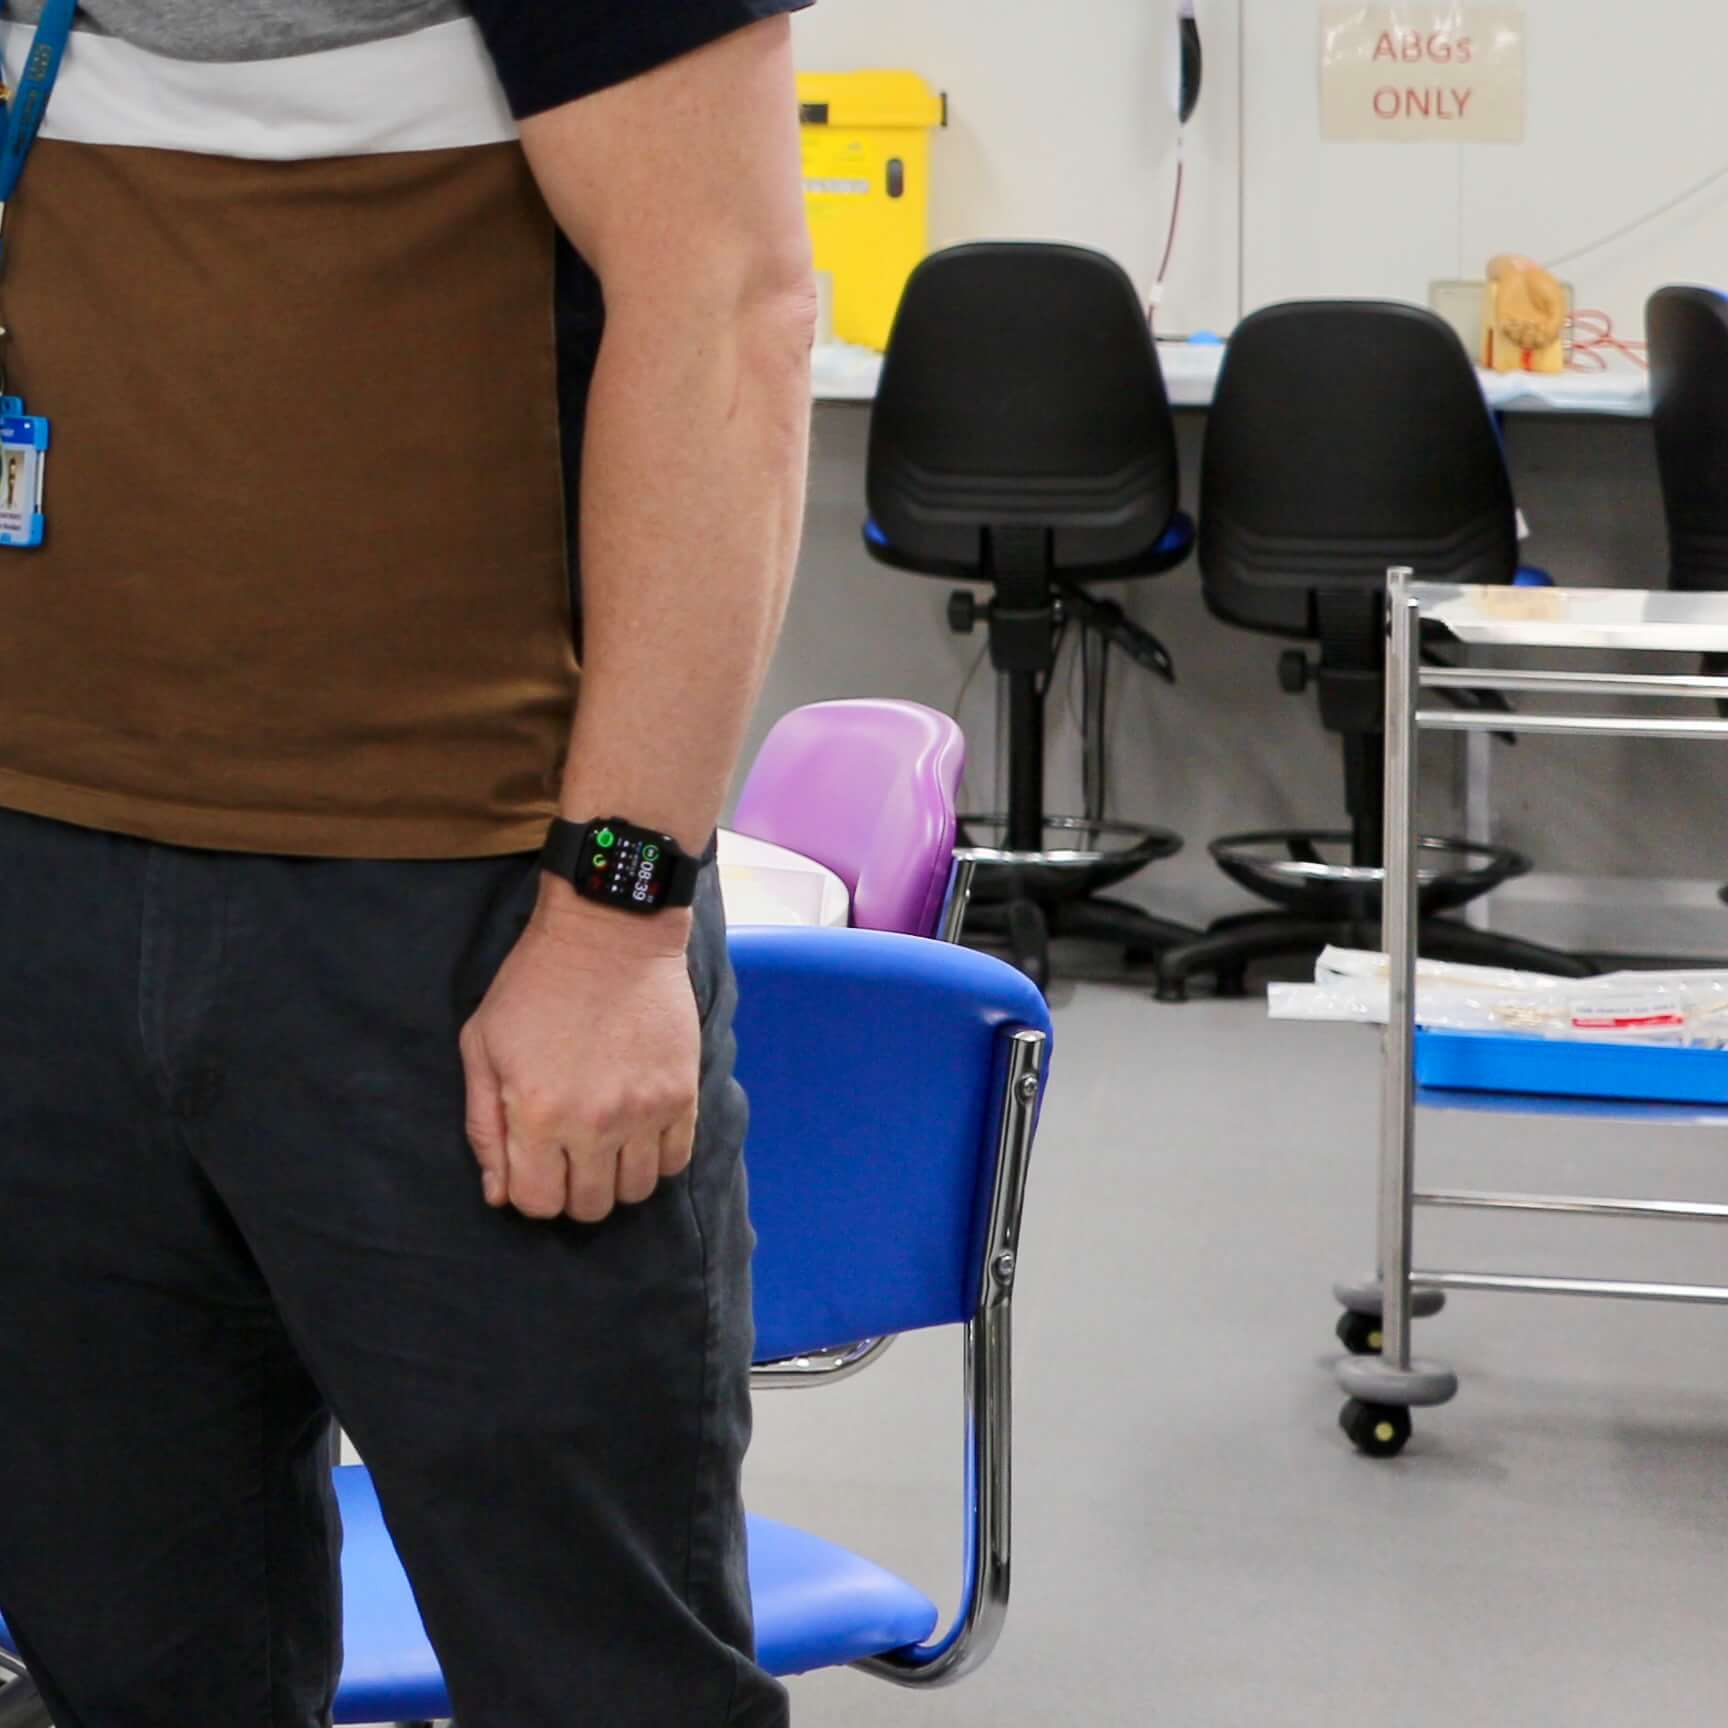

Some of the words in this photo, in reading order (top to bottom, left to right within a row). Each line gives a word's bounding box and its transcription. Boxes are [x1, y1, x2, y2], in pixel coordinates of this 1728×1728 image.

[1372, 30, 1473, 64] ABGs
[1372, 86, 1472, 119] ONLY
[632, 860, 654, 901] 08:39
